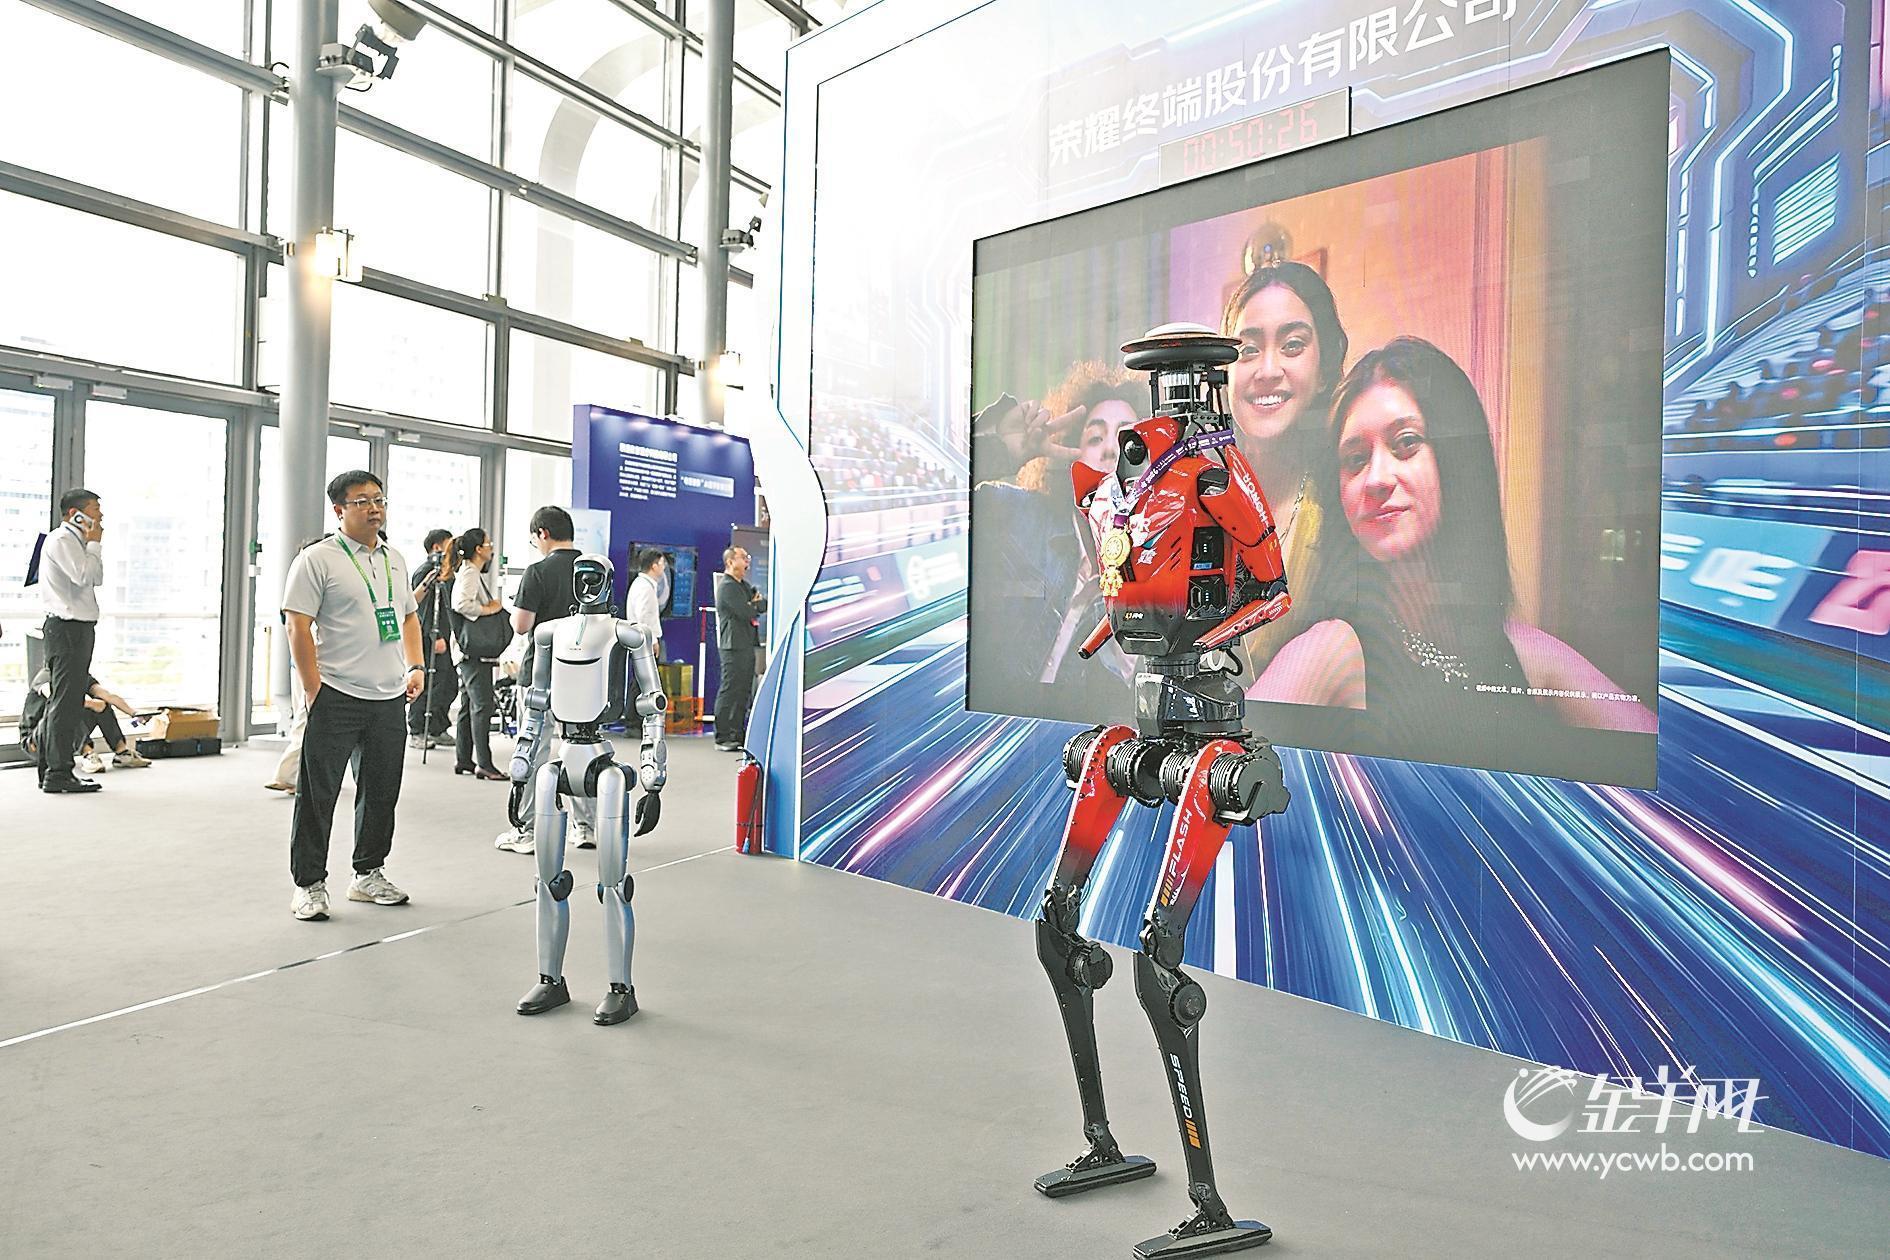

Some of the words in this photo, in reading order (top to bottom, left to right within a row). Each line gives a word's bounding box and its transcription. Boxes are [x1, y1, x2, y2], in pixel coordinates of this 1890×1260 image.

[1184, 102, 1319, 177] 00:50:26
[1243, 472, 1269, 526] HONOR
[1169, 807, 1193, 878] FLASH
[1170, 1053, 1193, 1119] SPEED
